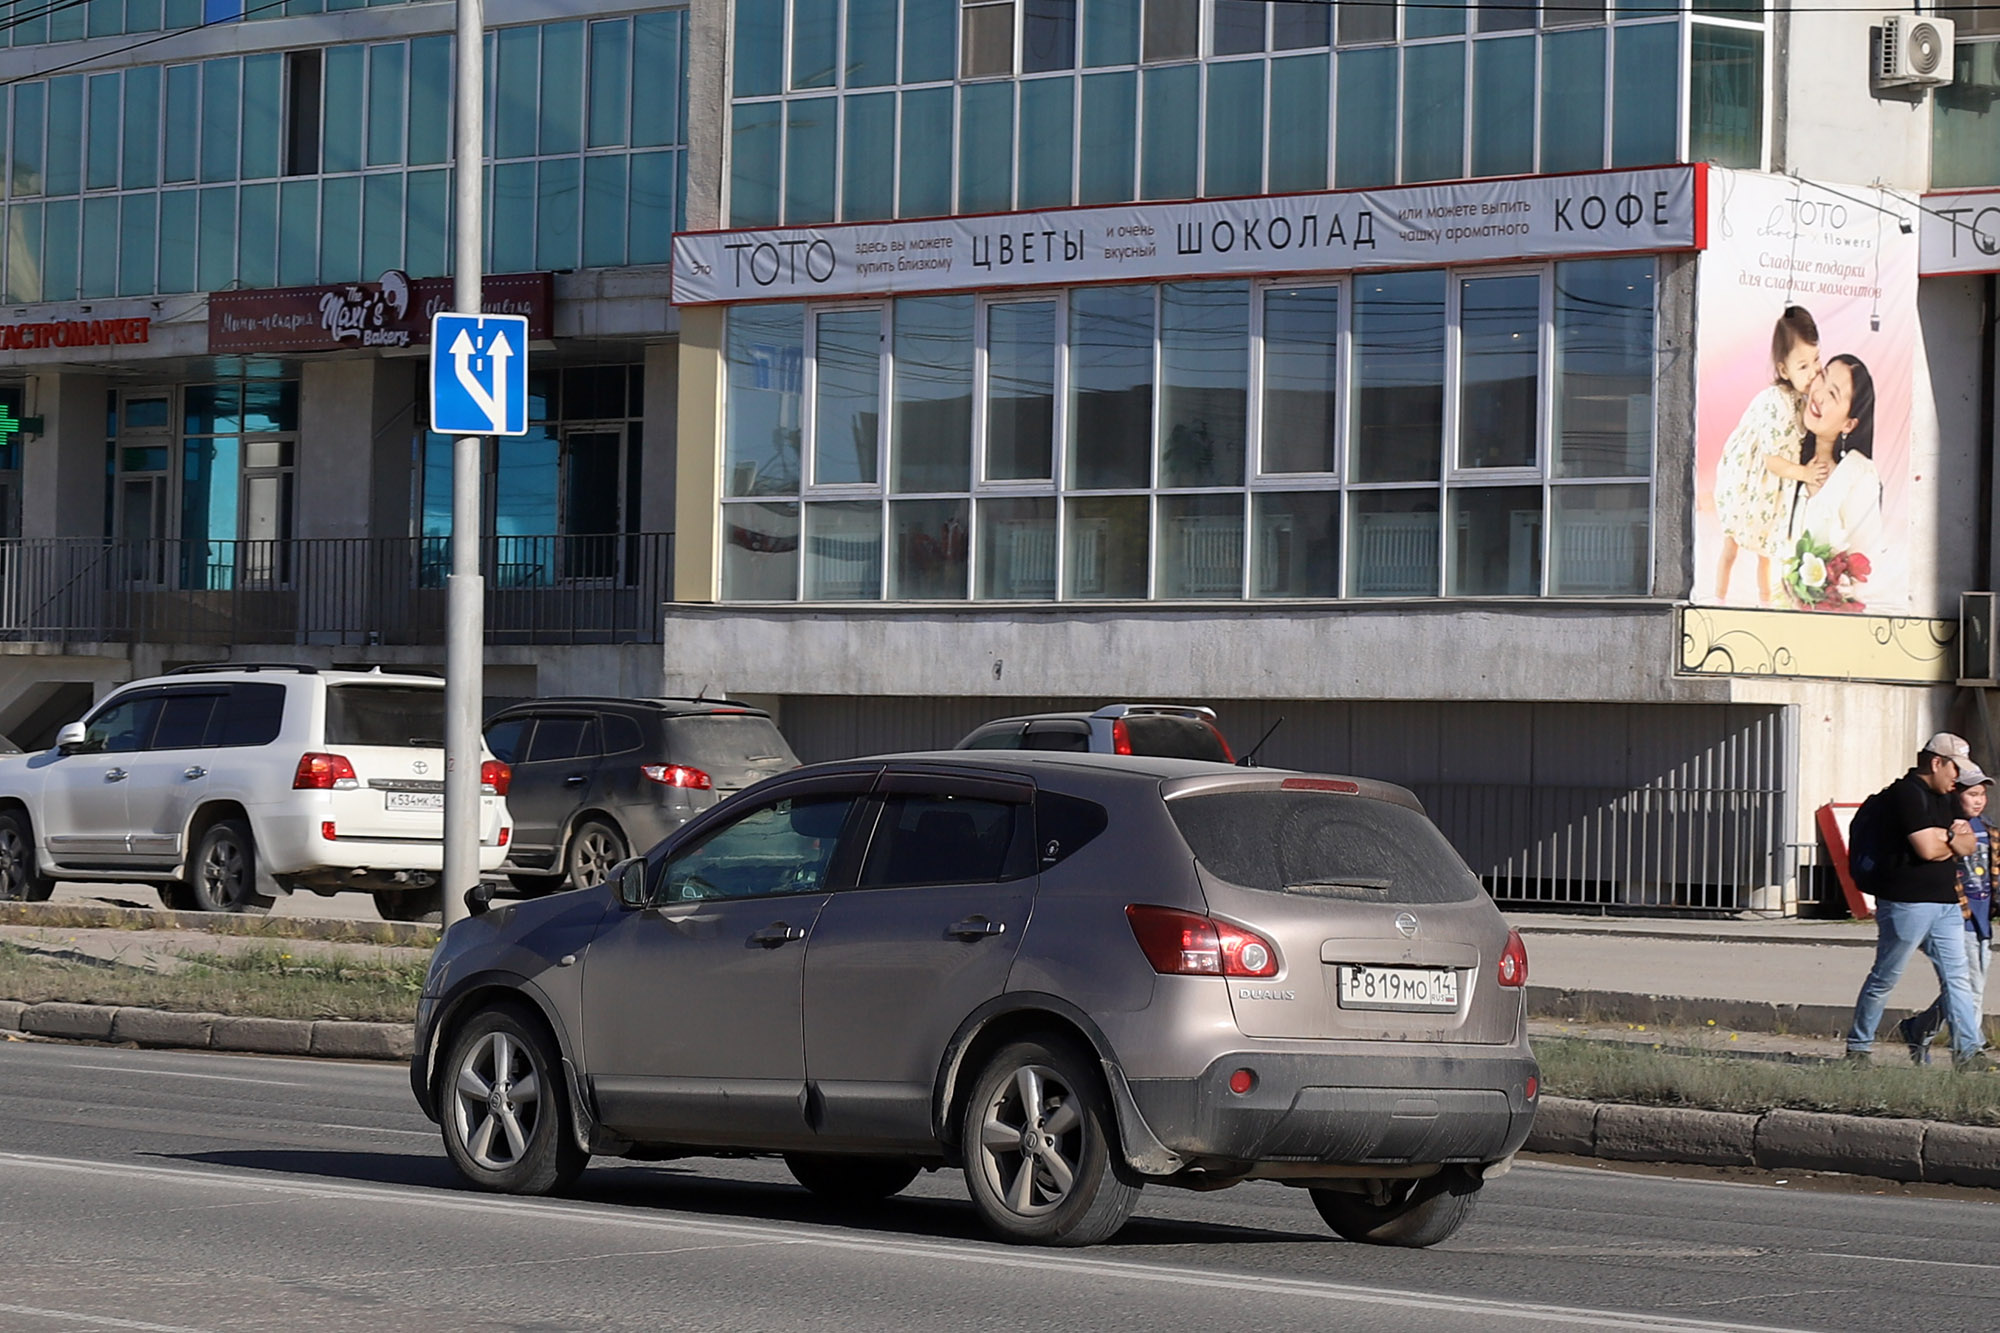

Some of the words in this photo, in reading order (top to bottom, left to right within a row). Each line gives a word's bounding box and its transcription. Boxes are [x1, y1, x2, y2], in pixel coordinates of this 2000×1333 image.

[1399, 206, 1423, 220] или
[1427, 203, 1477, 219] можете
[1481, 200, 1531, 216] выпить
[1554, 191, 1669, 232] КОФЕ
[1785, 198, 1847, 229] TOTO
[1106, 227, 1114, 237] и
[1118, 225, 1155, 237] очень
[1177, 211, 1375, 254] ШОКОЛАД
[1399, 227, 1442, 245] чашку
[1445, 223, 1530, 246] ароматного
[1824, 233, 1871, 248] flowers
[855, 241, 888, 255] здесь
[891, 240, 906, 251] вы
[908, 236, 954, 250] можете
[972, 229, 1084, 271] ЦВЕТЫ
[1104, 243, 1156, 262] вкусный
[691, 261, 712, 276] Это
[724, 239, 836, 288] ТОТО
[856, 260, 895, 275] купить
[898, 256, 954, 273] близкому
[1759, 251, 1812, 273] Сладкие
[1814, 260, 1866, 280] подарки
[346, 287, 363, 302] The
[1739, 270, 1761, 287] для
[1764, 275, 1816, 293] сладких
[1816, 283, 1882, 299] моментов
[0, 317, 151, 350] АСТРОМАРКЕТ
[363, 328, 410, 347] Bakery
[1239, 988, 1296, 1001] DUALIS
[1350, 971, 1428, 1000] Р819МО
[1433, 975, 1451, 994] 14
[1431, 994, 1445, 1002] RUS
